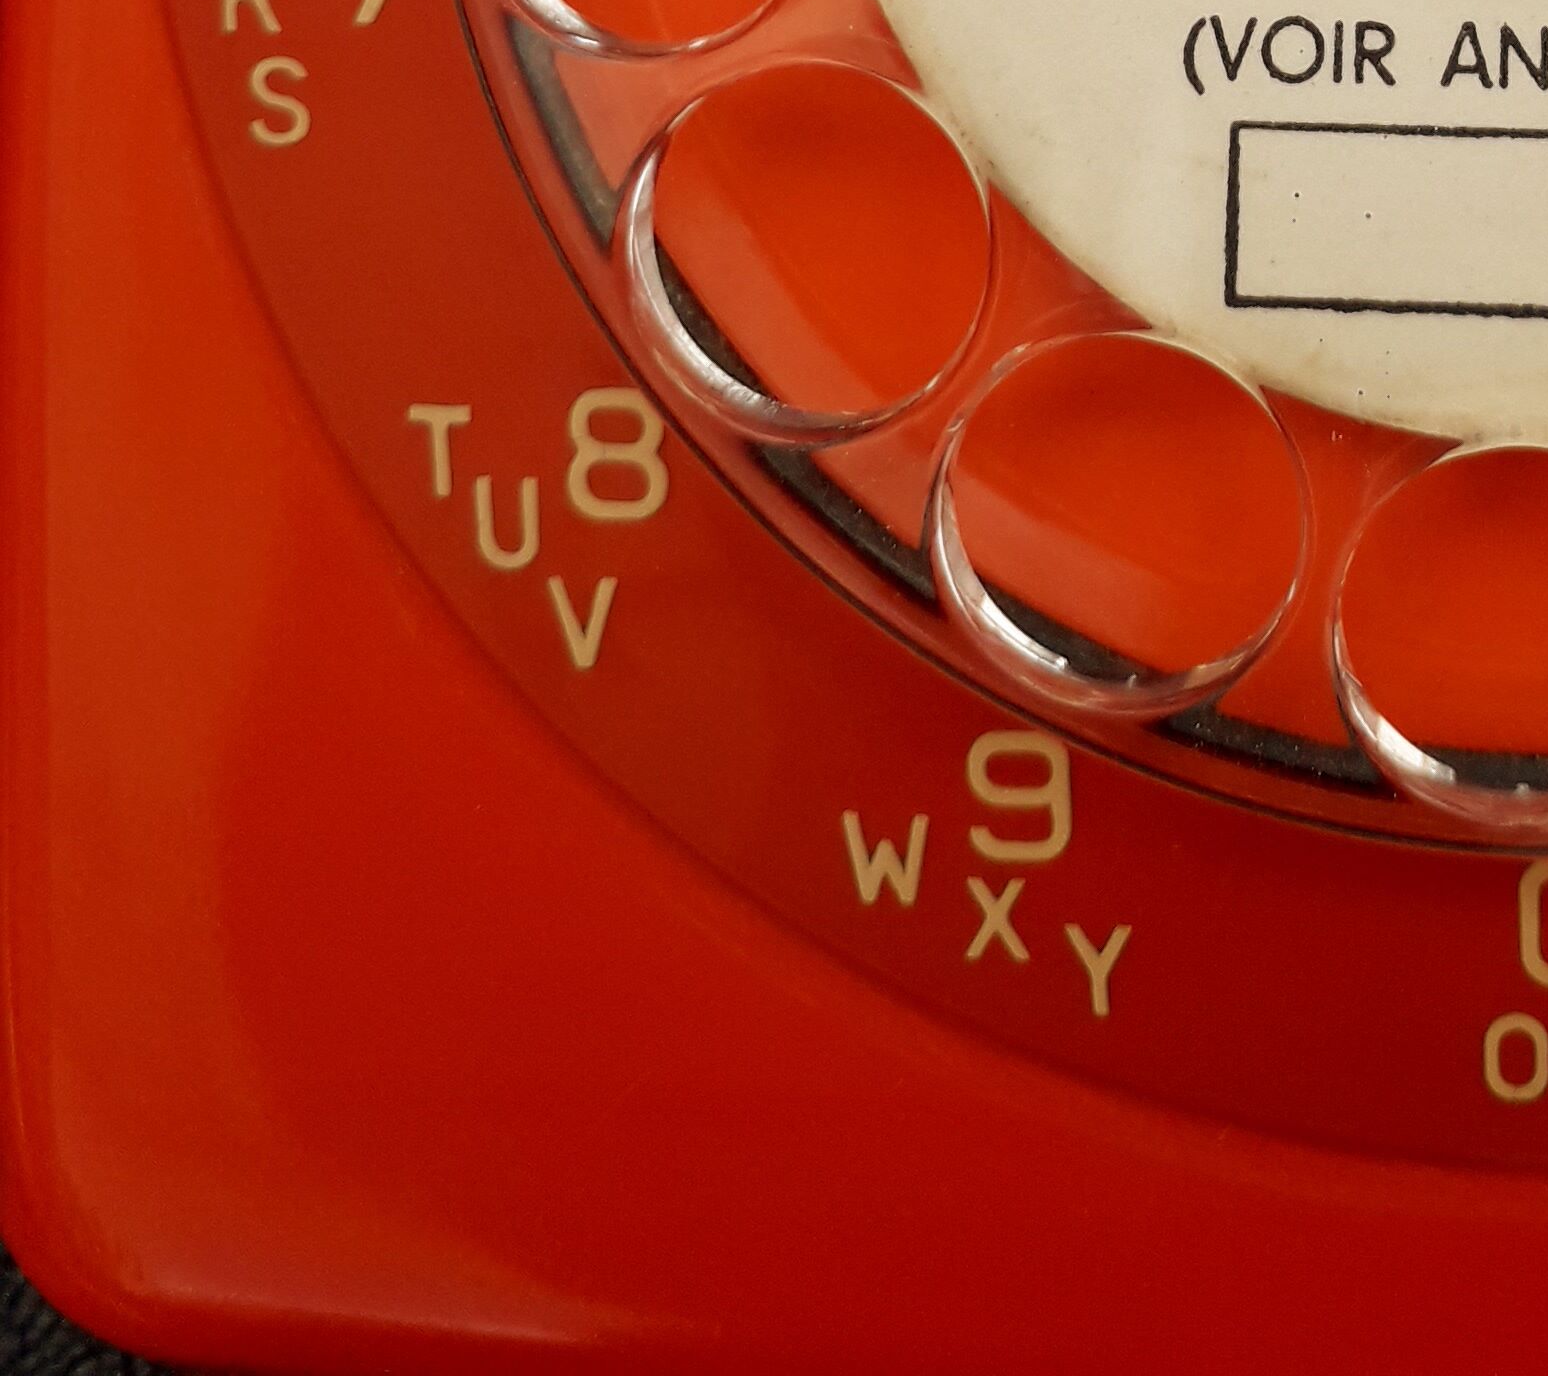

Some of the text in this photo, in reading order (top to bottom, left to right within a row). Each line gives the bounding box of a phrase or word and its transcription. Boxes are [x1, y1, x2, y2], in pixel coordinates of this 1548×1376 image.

[1181, 14, 1398, 97] (VOIR
[565, 386, 670, 521] 8
[964, 729, 1073, 865] 9
